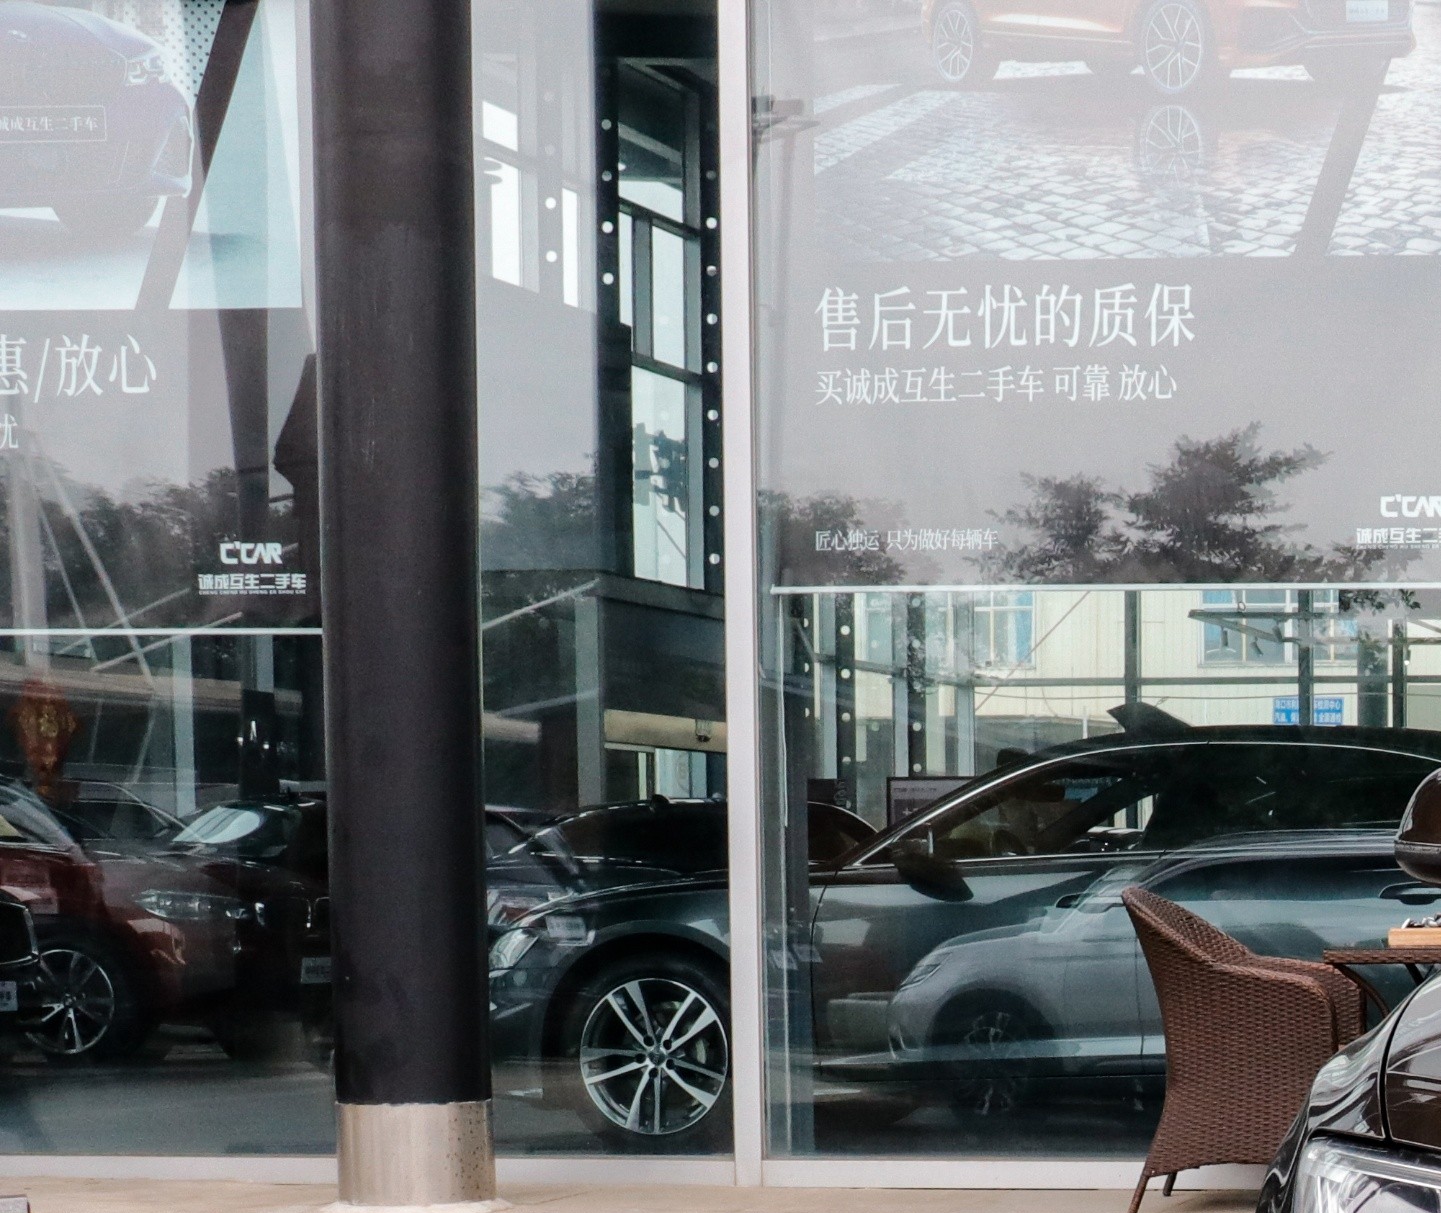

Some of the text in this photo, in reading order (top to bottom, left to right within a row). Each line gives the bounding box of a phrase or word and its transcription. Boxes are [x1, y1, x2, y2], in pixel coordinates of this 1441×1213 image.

[815, 282, 1196, 352] 售后无忧的质保
[815, 363, 1178, 405] 买诚成互生二手车 可靠 放心
[815, 528, 999, 551] 匠心独运 只为做好每辆车
[197, 573, 307, 590] 诚成互生二手车
